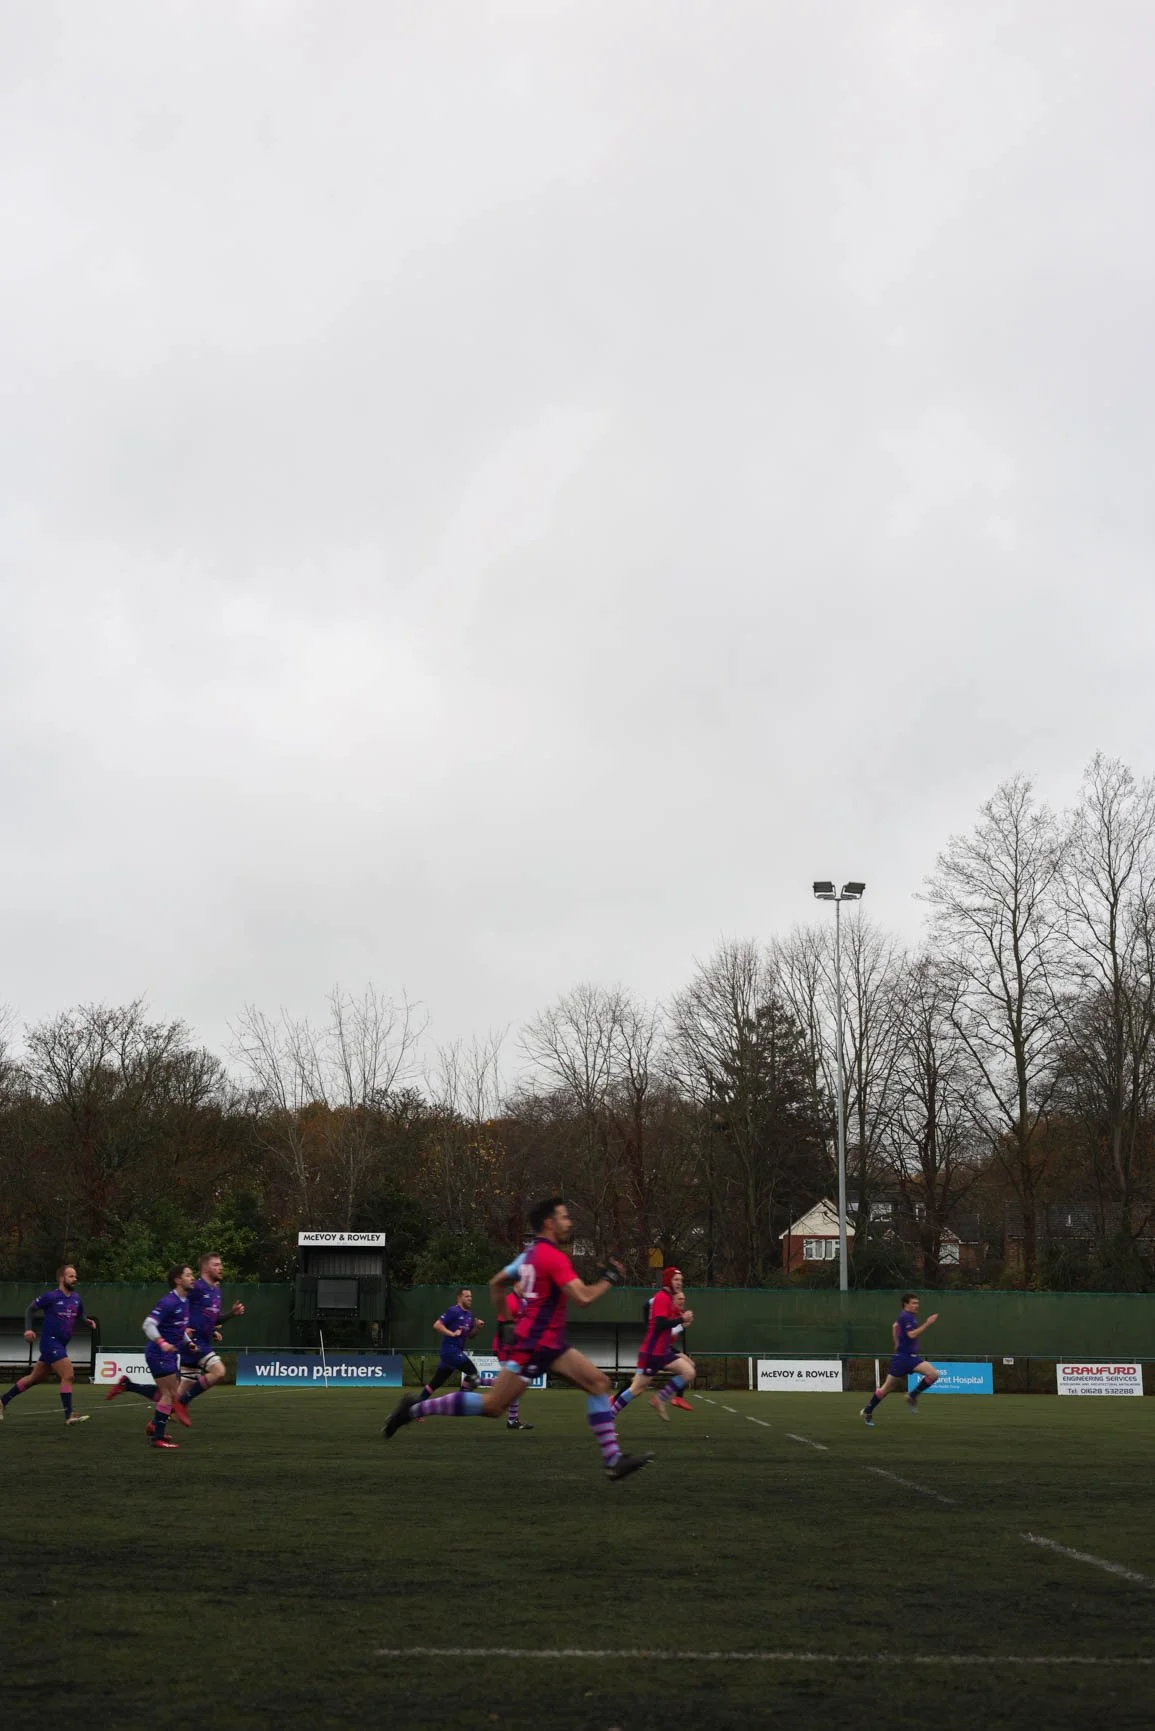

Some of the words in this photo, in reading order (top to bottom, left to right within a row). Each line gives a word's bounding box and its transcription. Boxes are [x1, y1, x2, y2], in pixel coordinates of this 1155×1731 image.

[347, 1234, 381, 1242] ROWLEY
[255, 1361, 308, 1377] wilson
[1062, 1366, 1137, 1375] CRAUFURD
[761, 1370, 795, 1378] McEVOY
[796, 1370, 803, 1378] &
[805, 1370, 840, 1378] ROWLEY
[953, 1375, 984, 1385] Hospital
